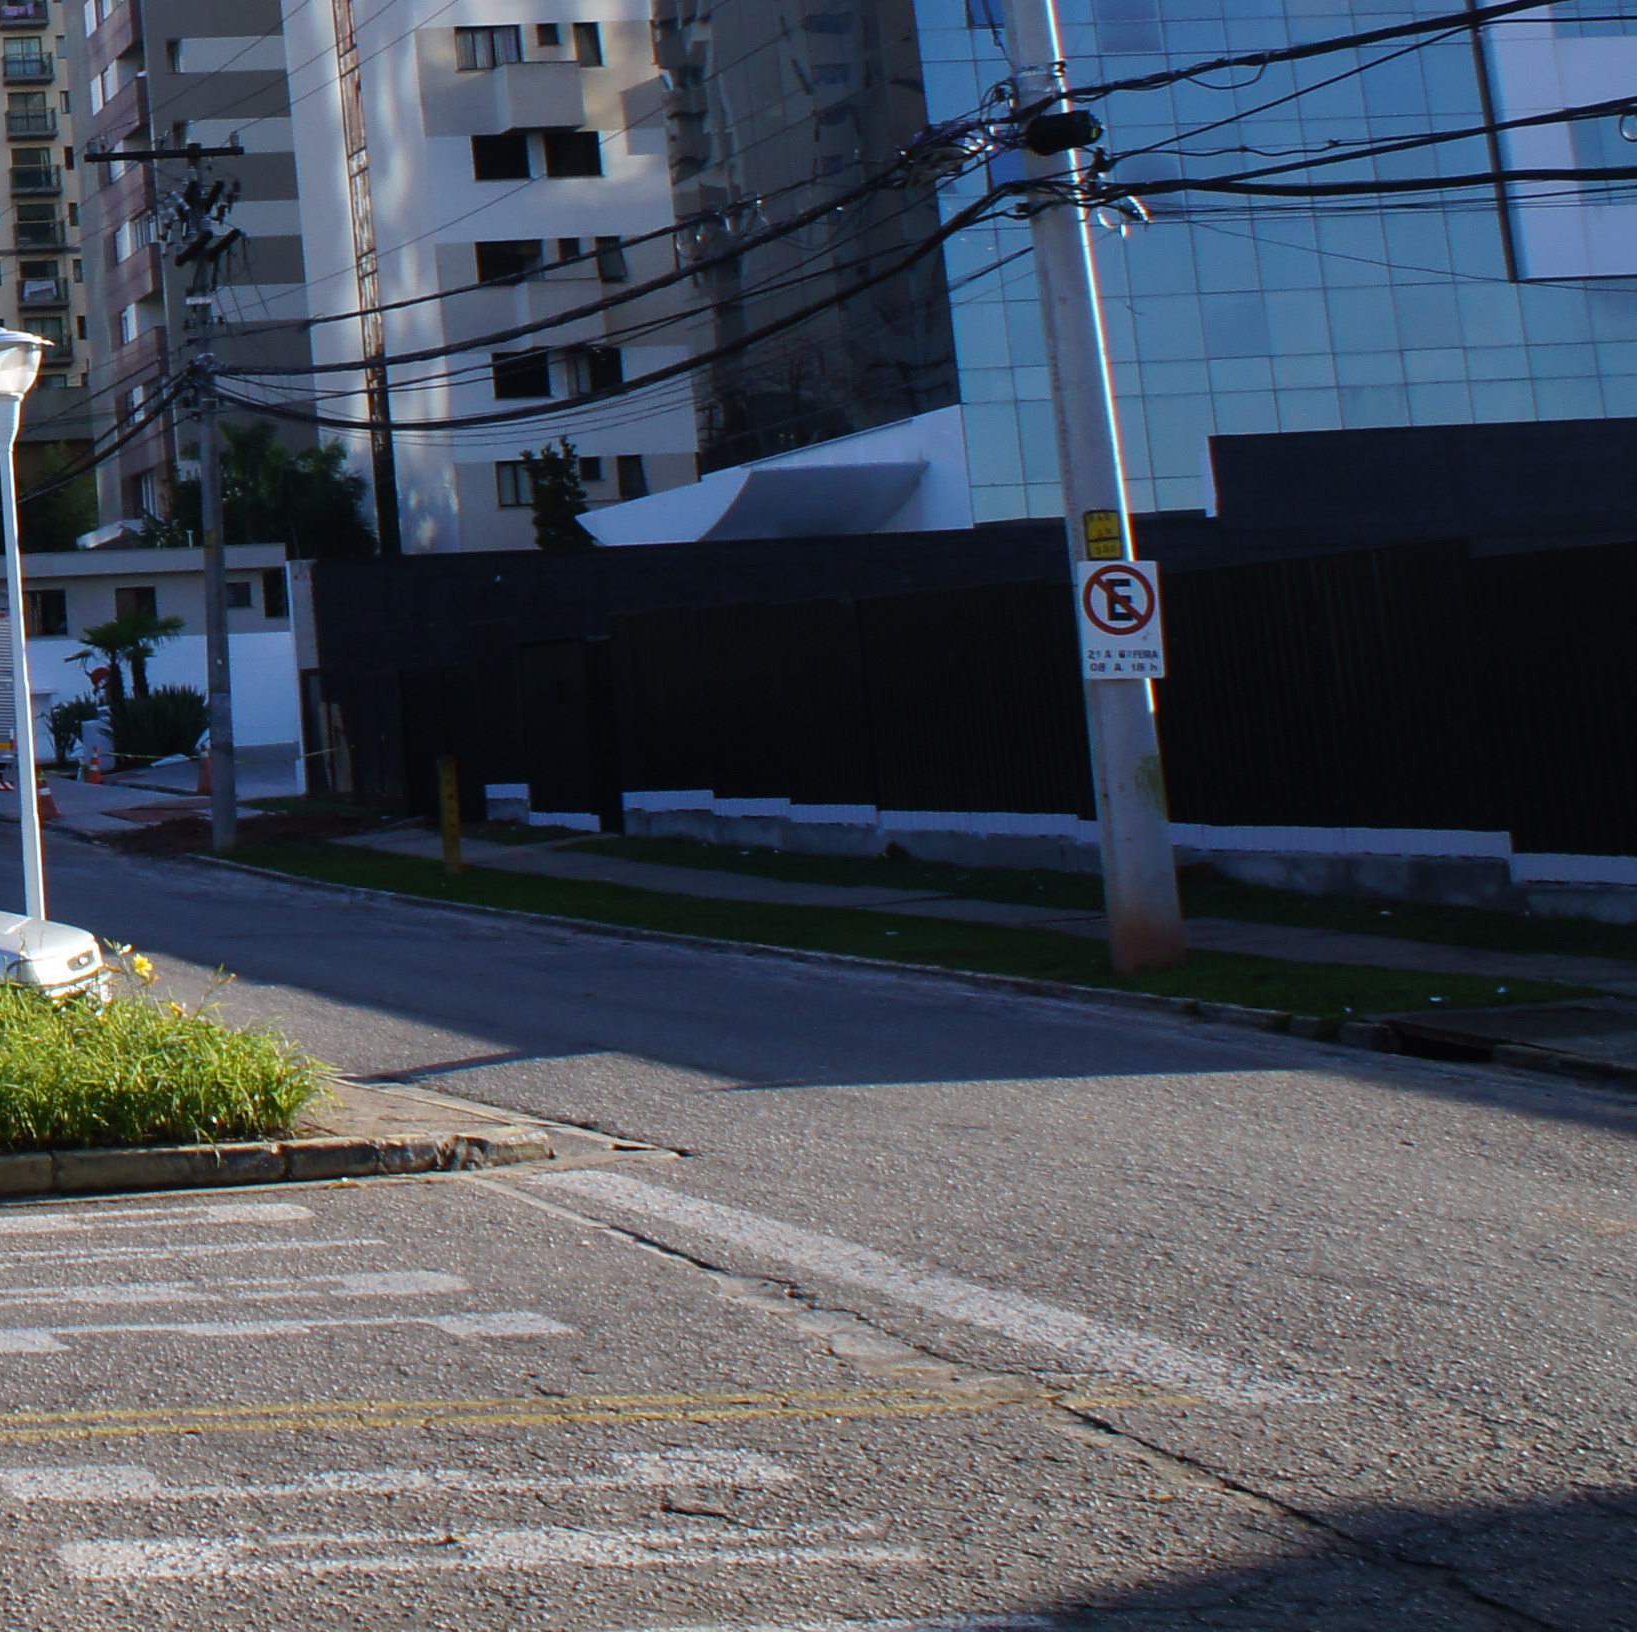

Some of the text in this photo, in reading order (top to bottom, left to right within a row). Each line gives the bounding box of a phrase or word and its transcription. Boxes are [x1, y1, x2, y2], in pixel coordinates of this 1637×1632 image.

[1106, 577, 1134, 622] E
[1104, 650, 1111, 658] A
[1089, 663, 1105, 672] 08
[1113, 663, 1122, 671] A
